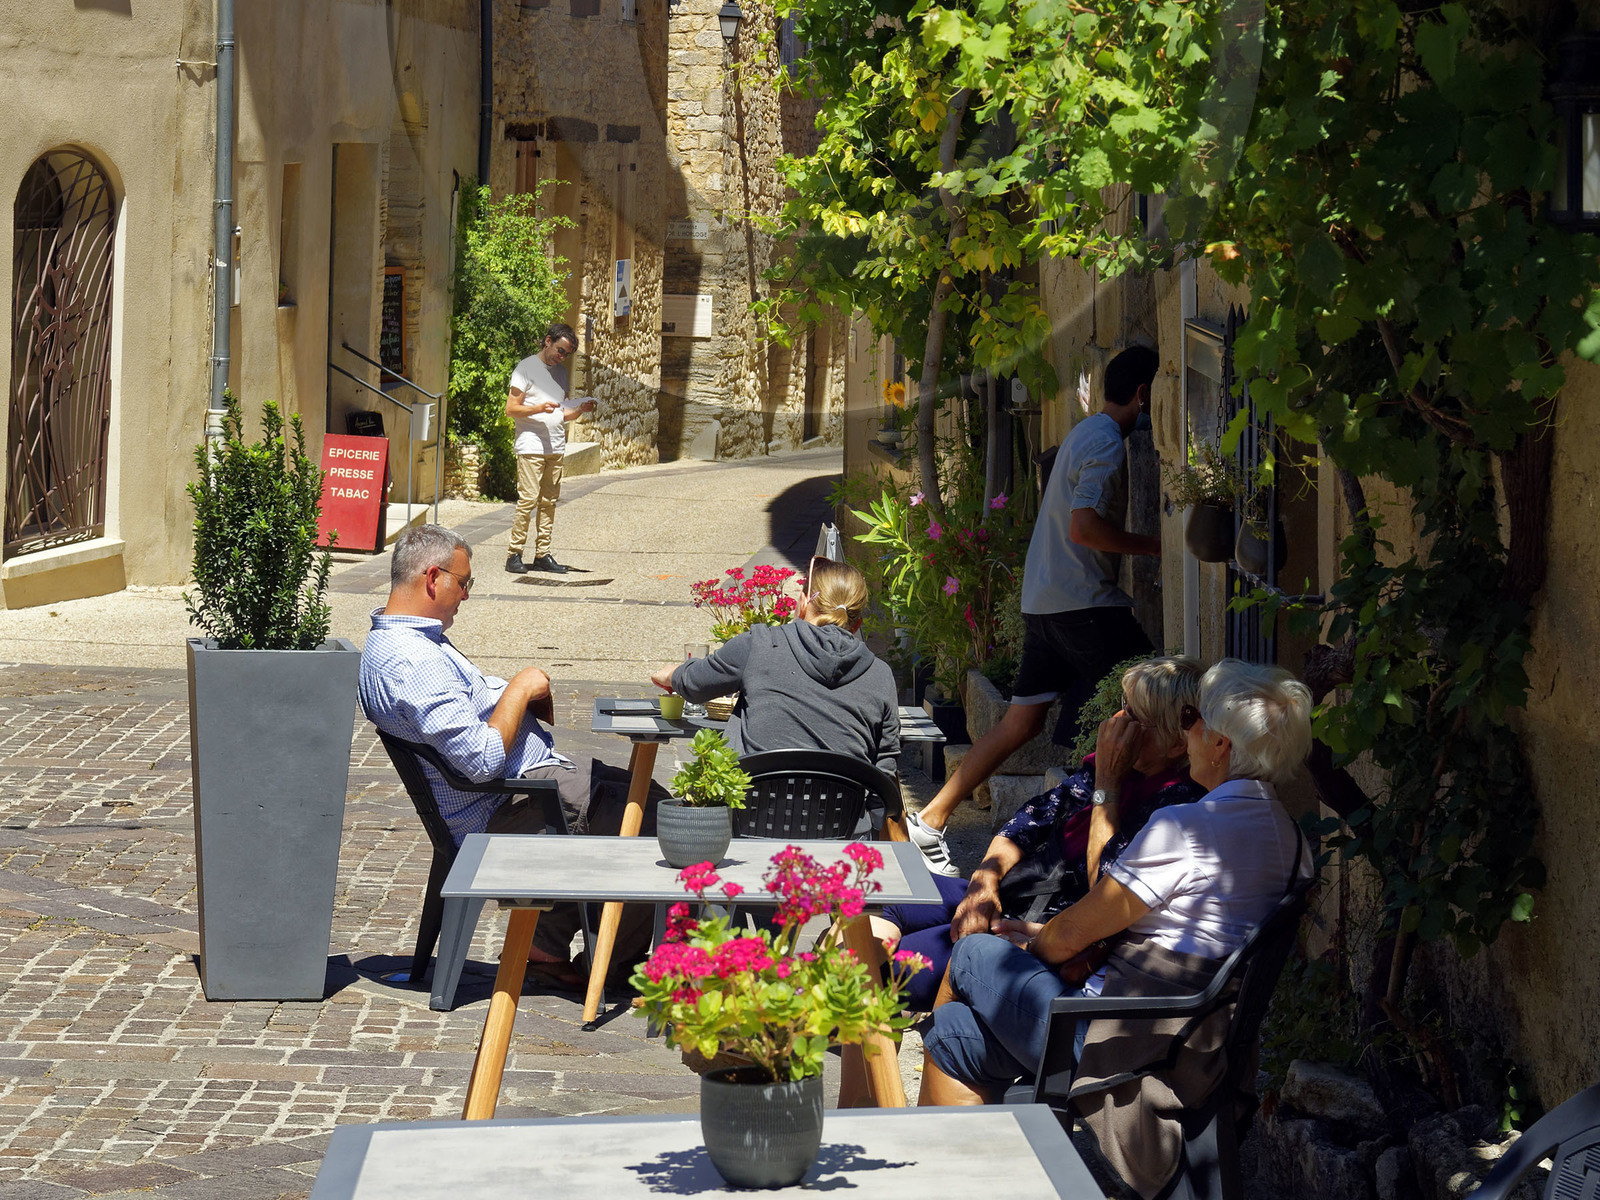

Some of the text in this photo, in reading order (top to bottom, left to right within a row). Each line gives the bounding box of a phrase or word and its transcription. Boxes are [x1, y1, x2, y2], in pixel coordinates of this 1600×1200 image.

[329, 447, 380, 461] EPICERIE
[330, 467, 374, 480] PRESSE
[330, 487, 370, 499] TABAC
